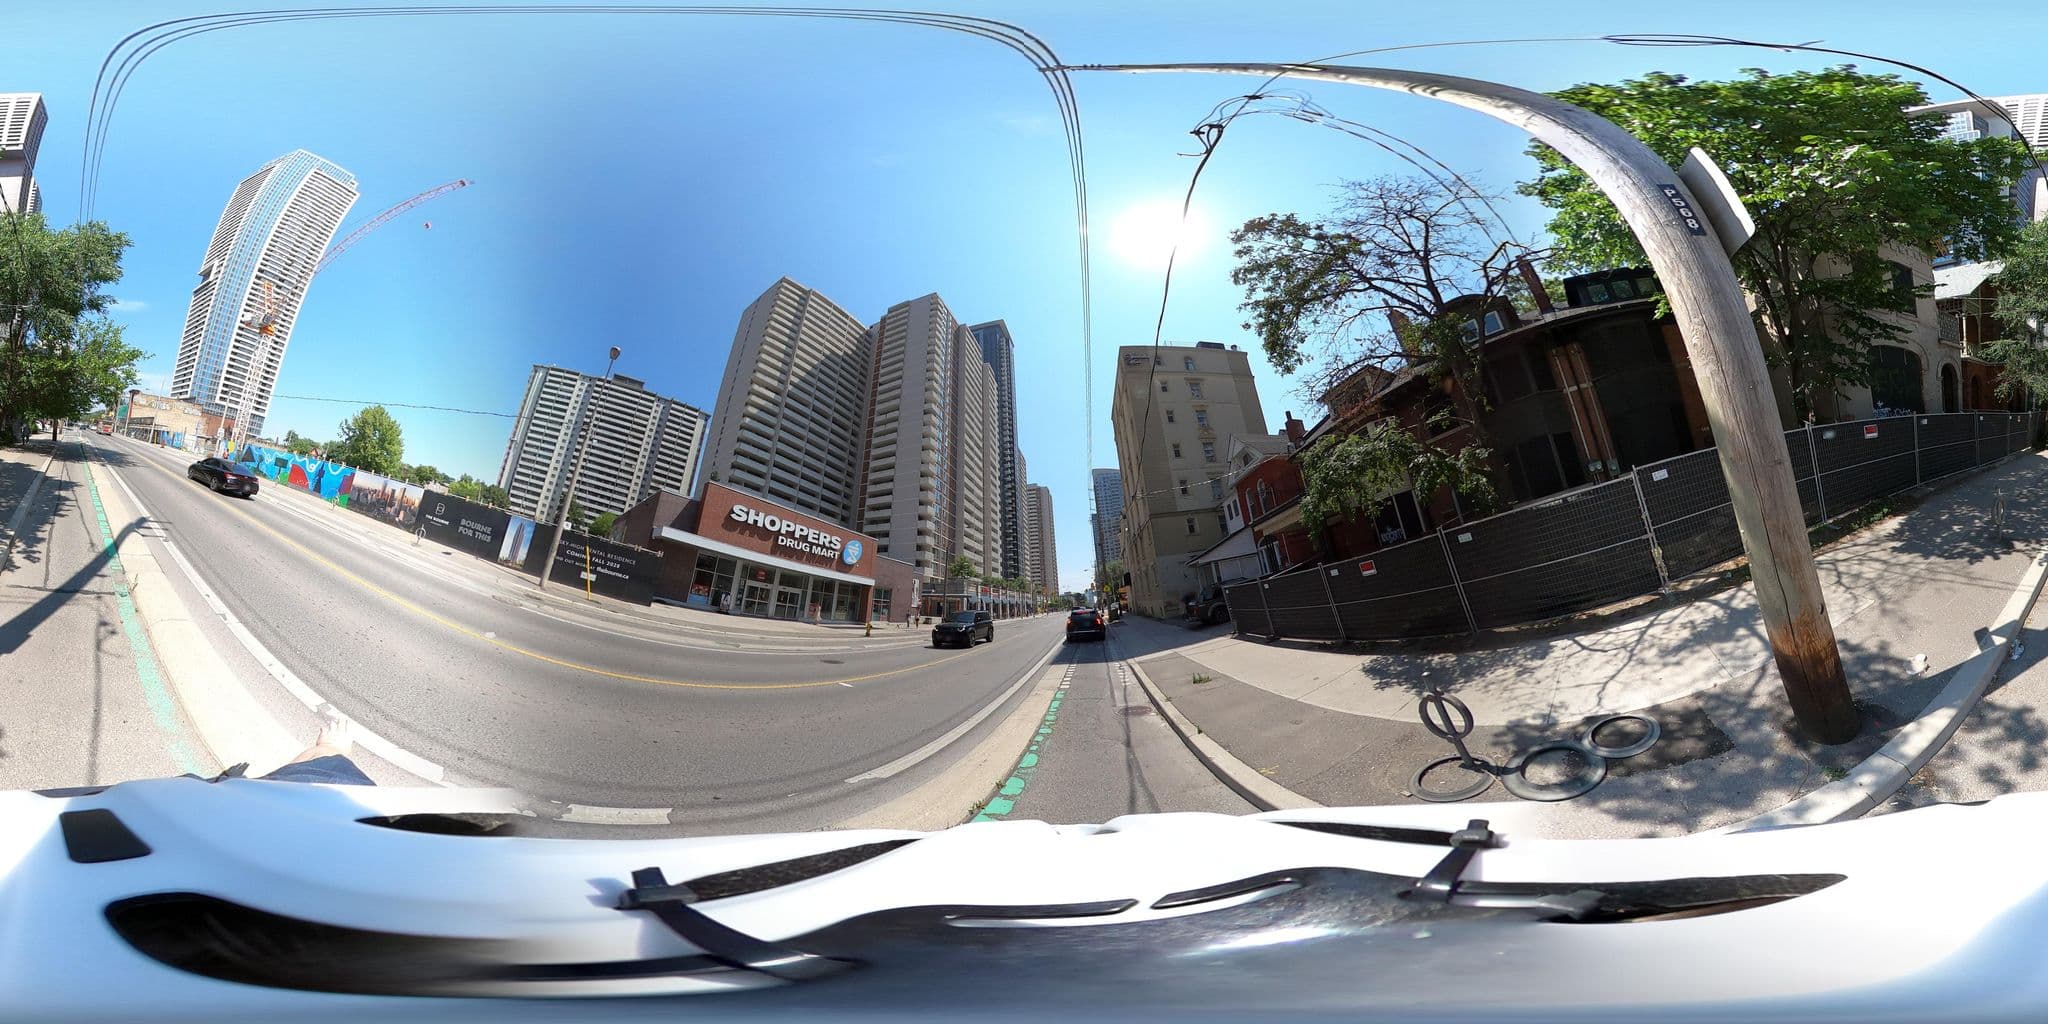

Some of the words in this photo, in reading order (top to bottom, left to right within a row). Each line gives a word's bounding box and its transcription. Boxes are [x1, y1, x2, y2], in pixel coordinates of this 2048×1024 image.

[1663, 188, 1700, 230] P568
[460, 518, 493, 534] BOURNE
[730, 504, 842, 549] SHOPPERS
[458, 527, 473, 537] FOR
[475, 531, 492, 543] THIS
[778, 535, 810, 552] DRUG
[811, 545, 840, 560] MART
[566, 549, 589, 560] COMIN
[591, 557, 605, 565] FALL
[607, 553, 636, 565] RESIDENCE
[596, 566, 629, 579] thebourne.ca
